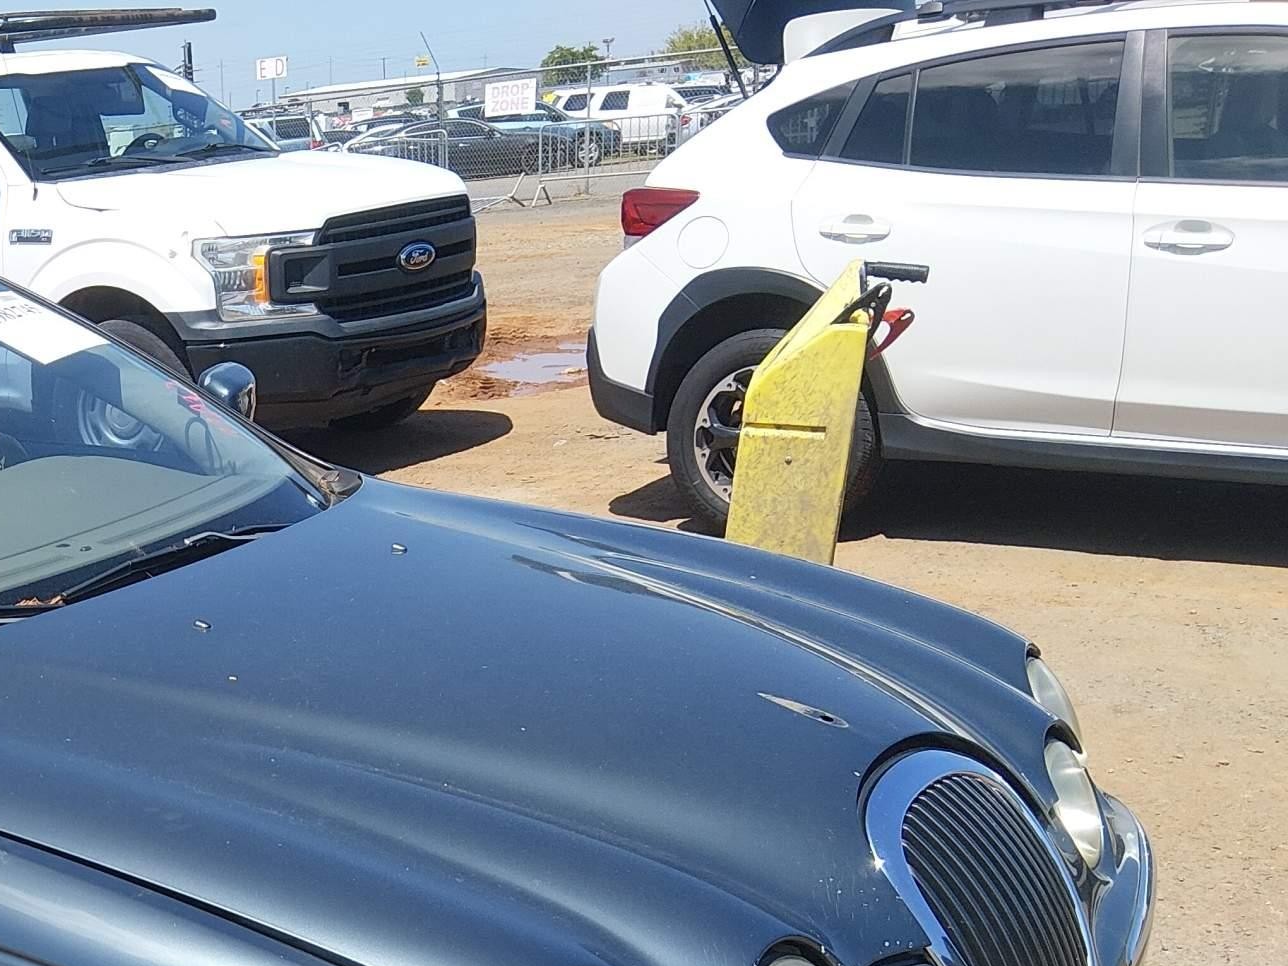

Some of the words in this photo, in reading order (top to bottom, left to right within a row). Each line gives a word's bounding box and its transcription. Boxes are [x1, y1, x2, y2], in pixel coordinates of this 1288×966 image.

[491, 82, 530, 98] DROP
[491, 97, 530, 113] ZONE
[409, 249, 429, 265] Ford
